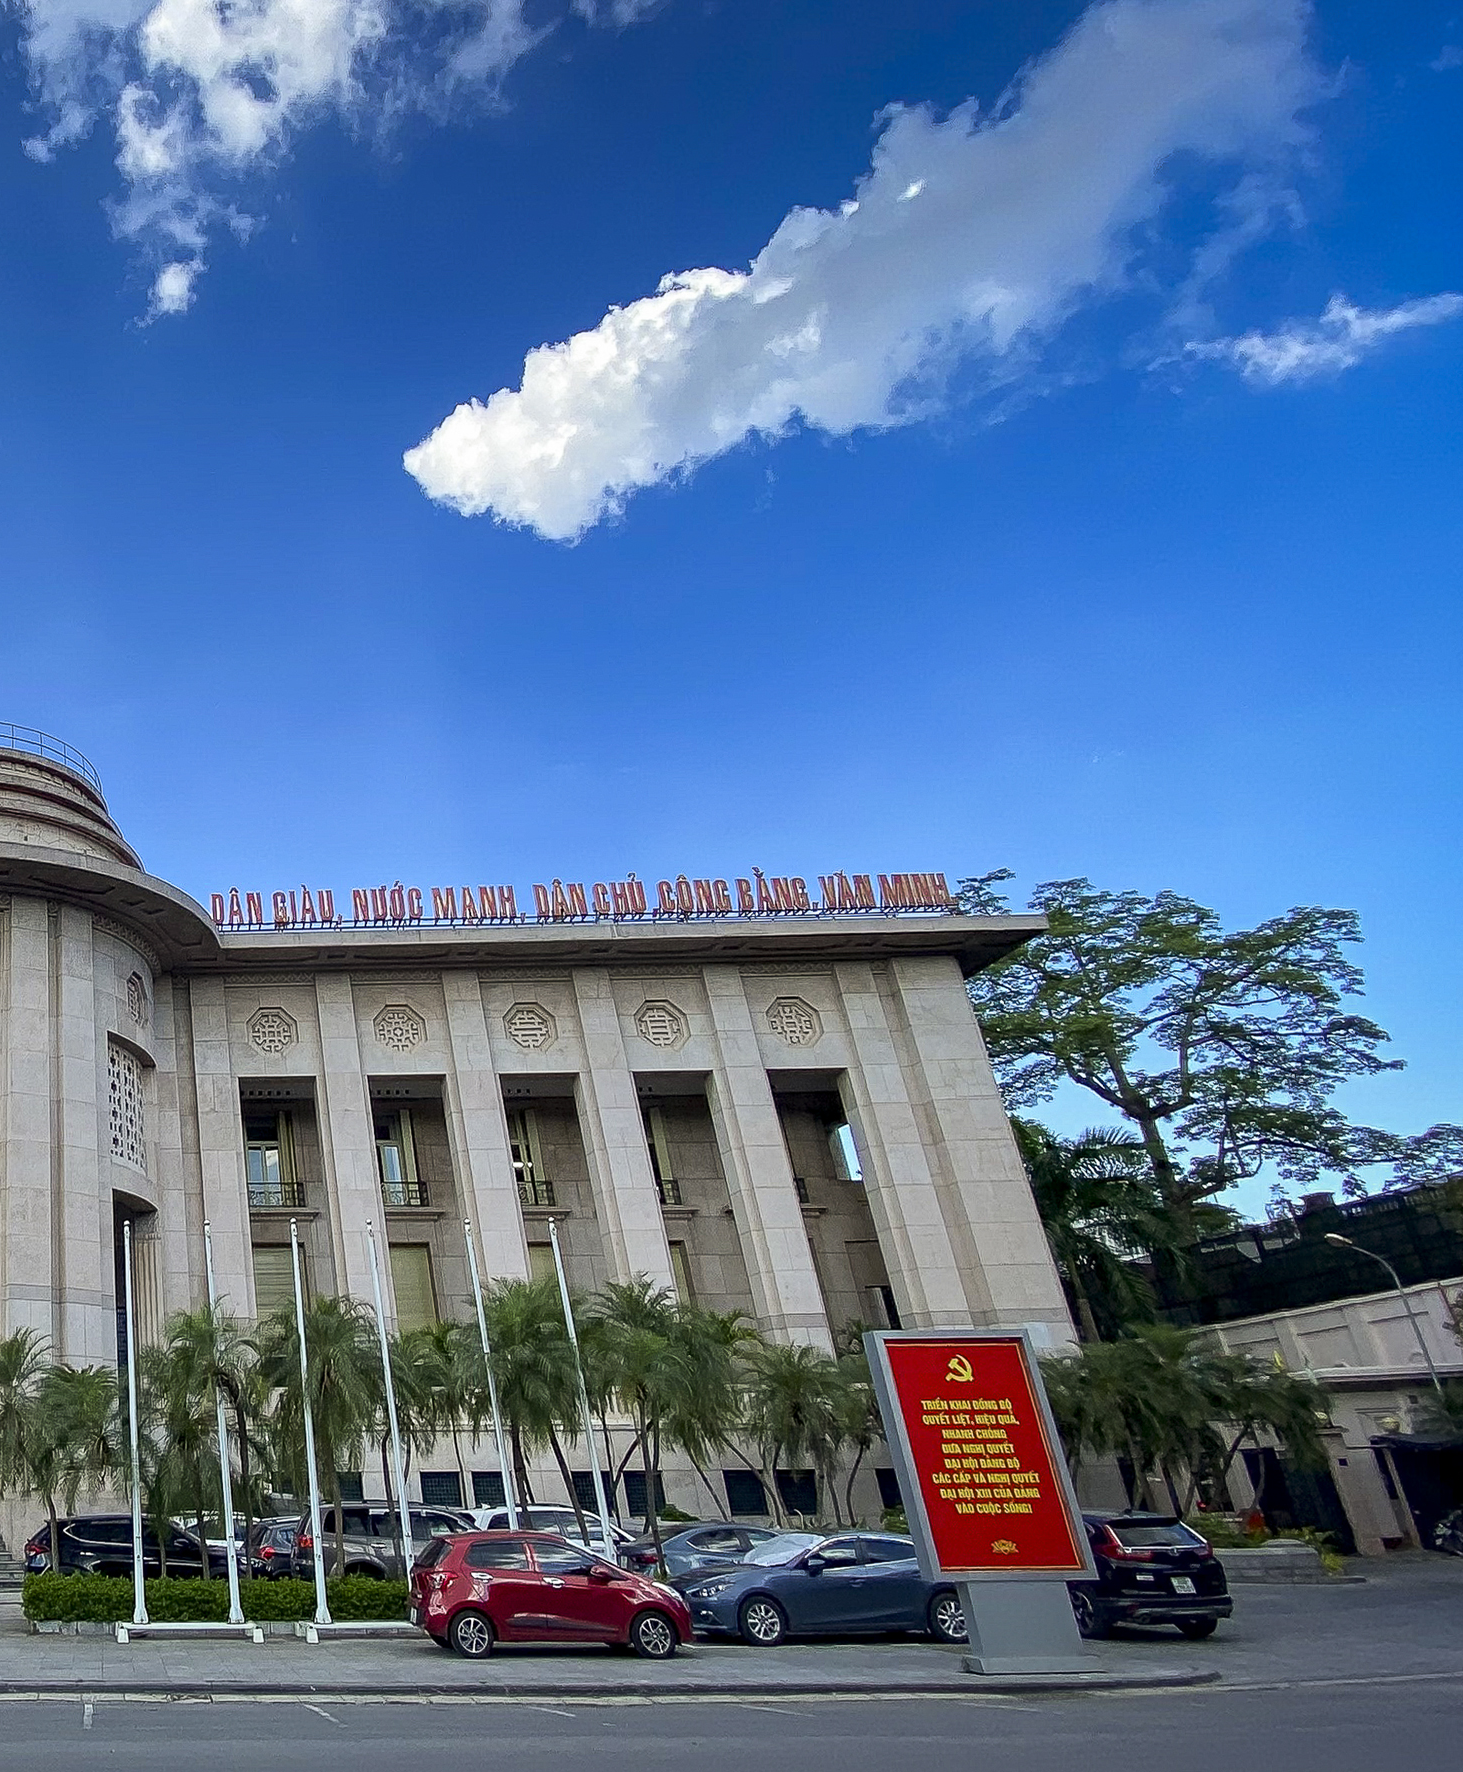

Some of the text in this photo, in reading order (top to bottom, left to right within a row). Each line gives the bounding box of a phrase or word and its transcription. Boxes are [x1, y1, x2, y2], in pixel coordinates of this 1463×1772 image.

[211, 887, 263, 925] DÂN
[273, 884, 343, 925] GIÀU,
[352, 881, 424, 921] NƯỚC
[431, 885, 526, 924] MẠNH,
[532, 878, 587, 920] DÂN
[656, 874, 731, 914] CÔNG
[735, 866, 819, 913] BẰNG,
[818, 870, 875, 910] VĂN
[877, 872, 952, 907] MINH
[921, 1398, 948, 1410] TRIỂN
[949, 1400, 971, 1410] KHAI
[922, 1412, 950, 1425] QUYẾT
[942, 1429, 974, 1439] NHANH
[986, 1441, 1014, 1453] QUYẾT
[932, 1472, 950, 1484] CÁC
[1012, 1470, 1040, 1483] QUYẾT
